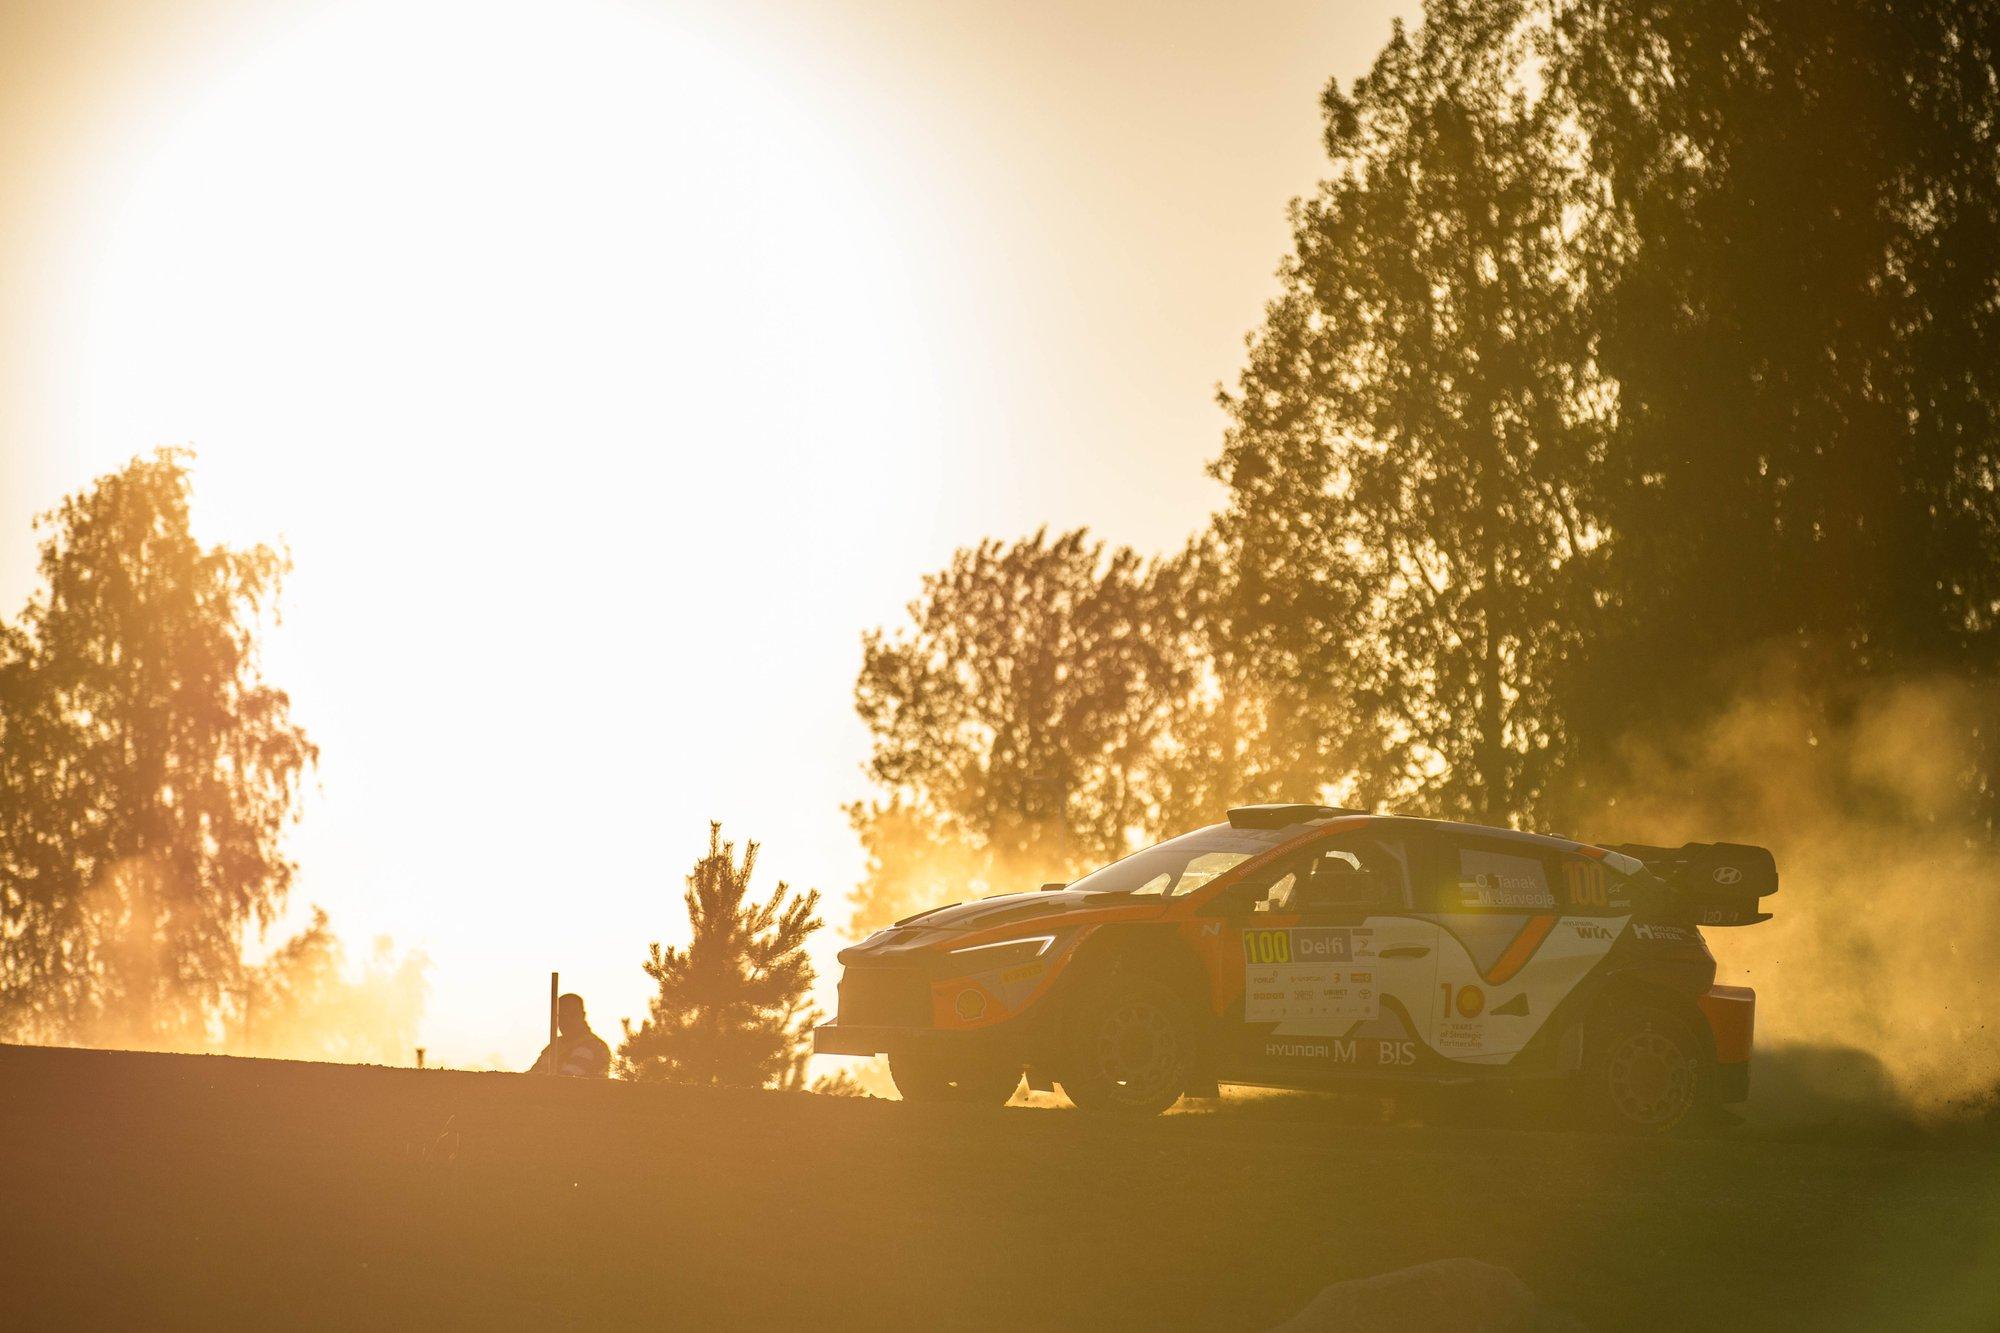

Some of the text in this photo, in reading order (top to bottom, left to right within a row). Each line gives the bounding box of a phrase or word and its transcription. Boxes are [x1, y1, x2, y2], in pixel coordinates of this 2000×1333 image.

[1562, 861, 1608, 906] 100
[1245, 931, 1344, 964] 100 Delfi
[1265, 1043, 1329, 1058] HYUNDAI
